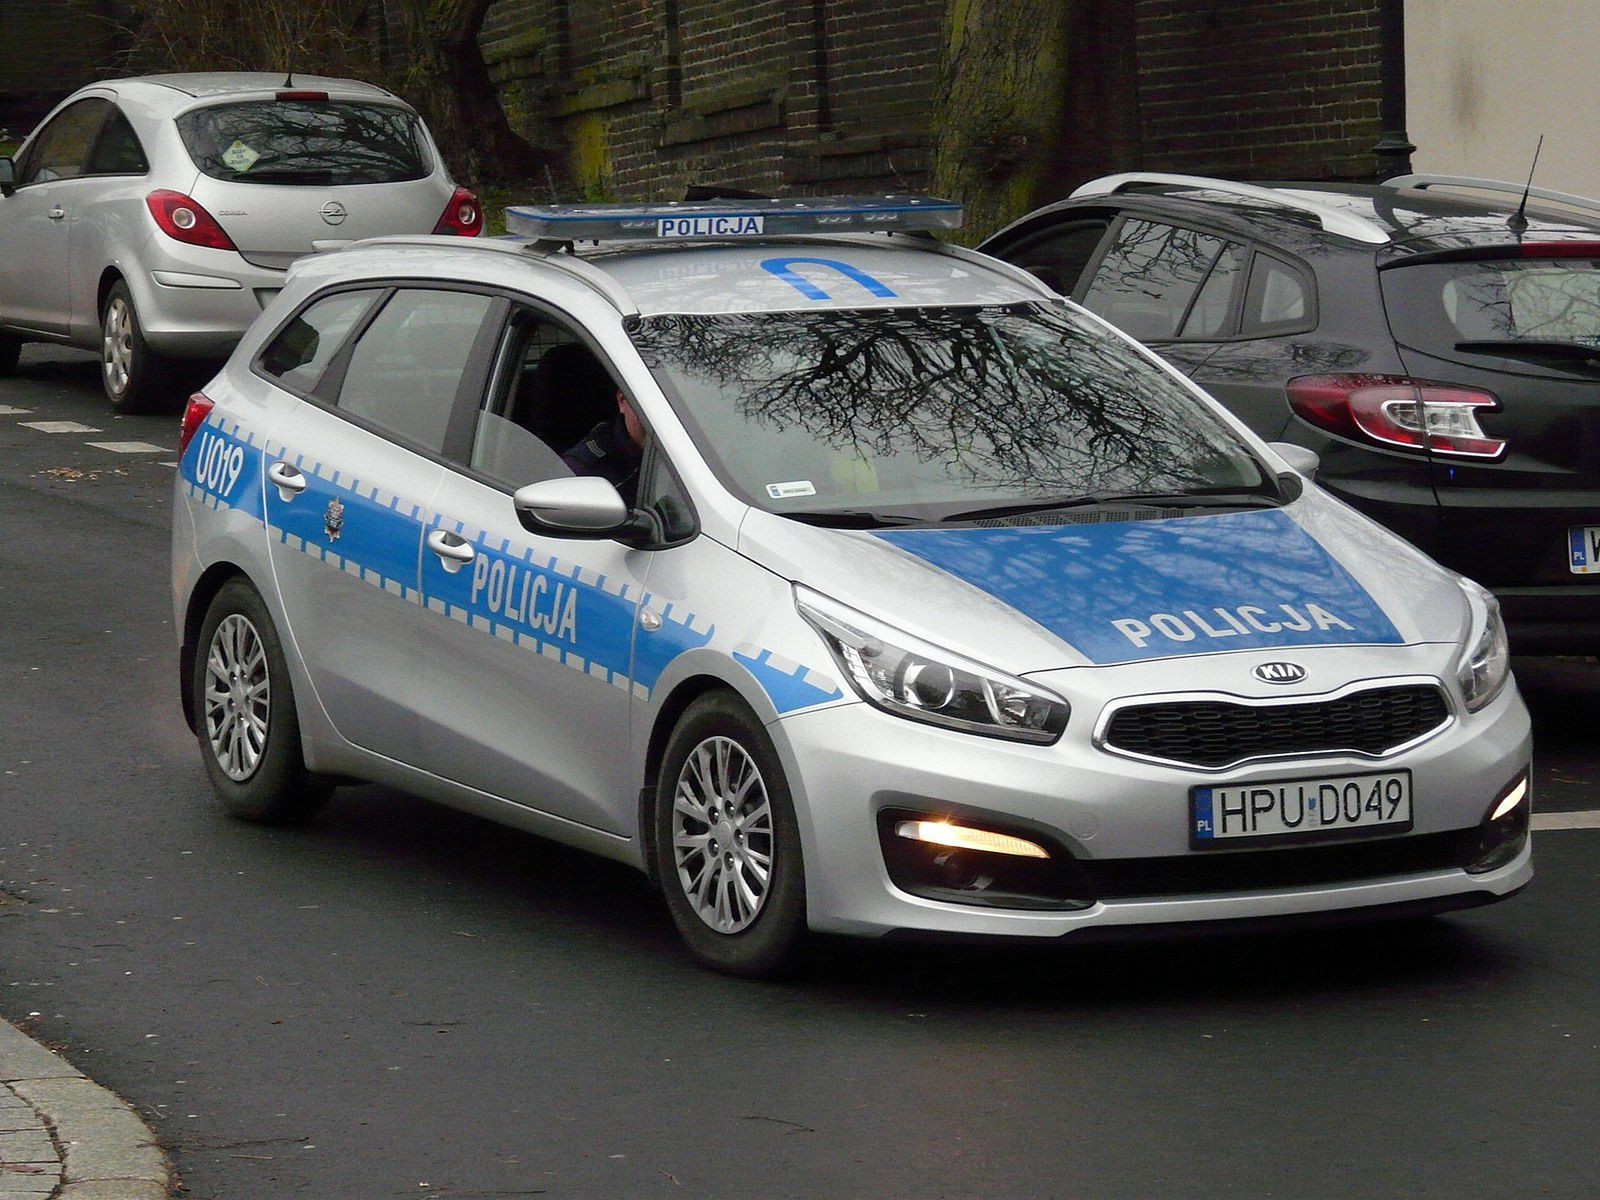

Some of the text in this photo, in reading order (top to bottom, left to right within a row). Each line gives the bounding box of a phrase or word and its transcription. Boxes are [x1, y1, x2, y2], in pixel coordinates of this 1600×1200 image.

[661, 217, 759, 236] POLICJA
[196, 431, 244, 497] U019
[1573, 551, 1585, 561] PL
[471, 552, 577, 643] POLICJA
[1110, 604, 1356, 648] POLICJA
[1260, 664, 1303, 679] KIA
[1220, 778, 1403, 834] HPU D049
[1197, 819, 1211, 833] PL
